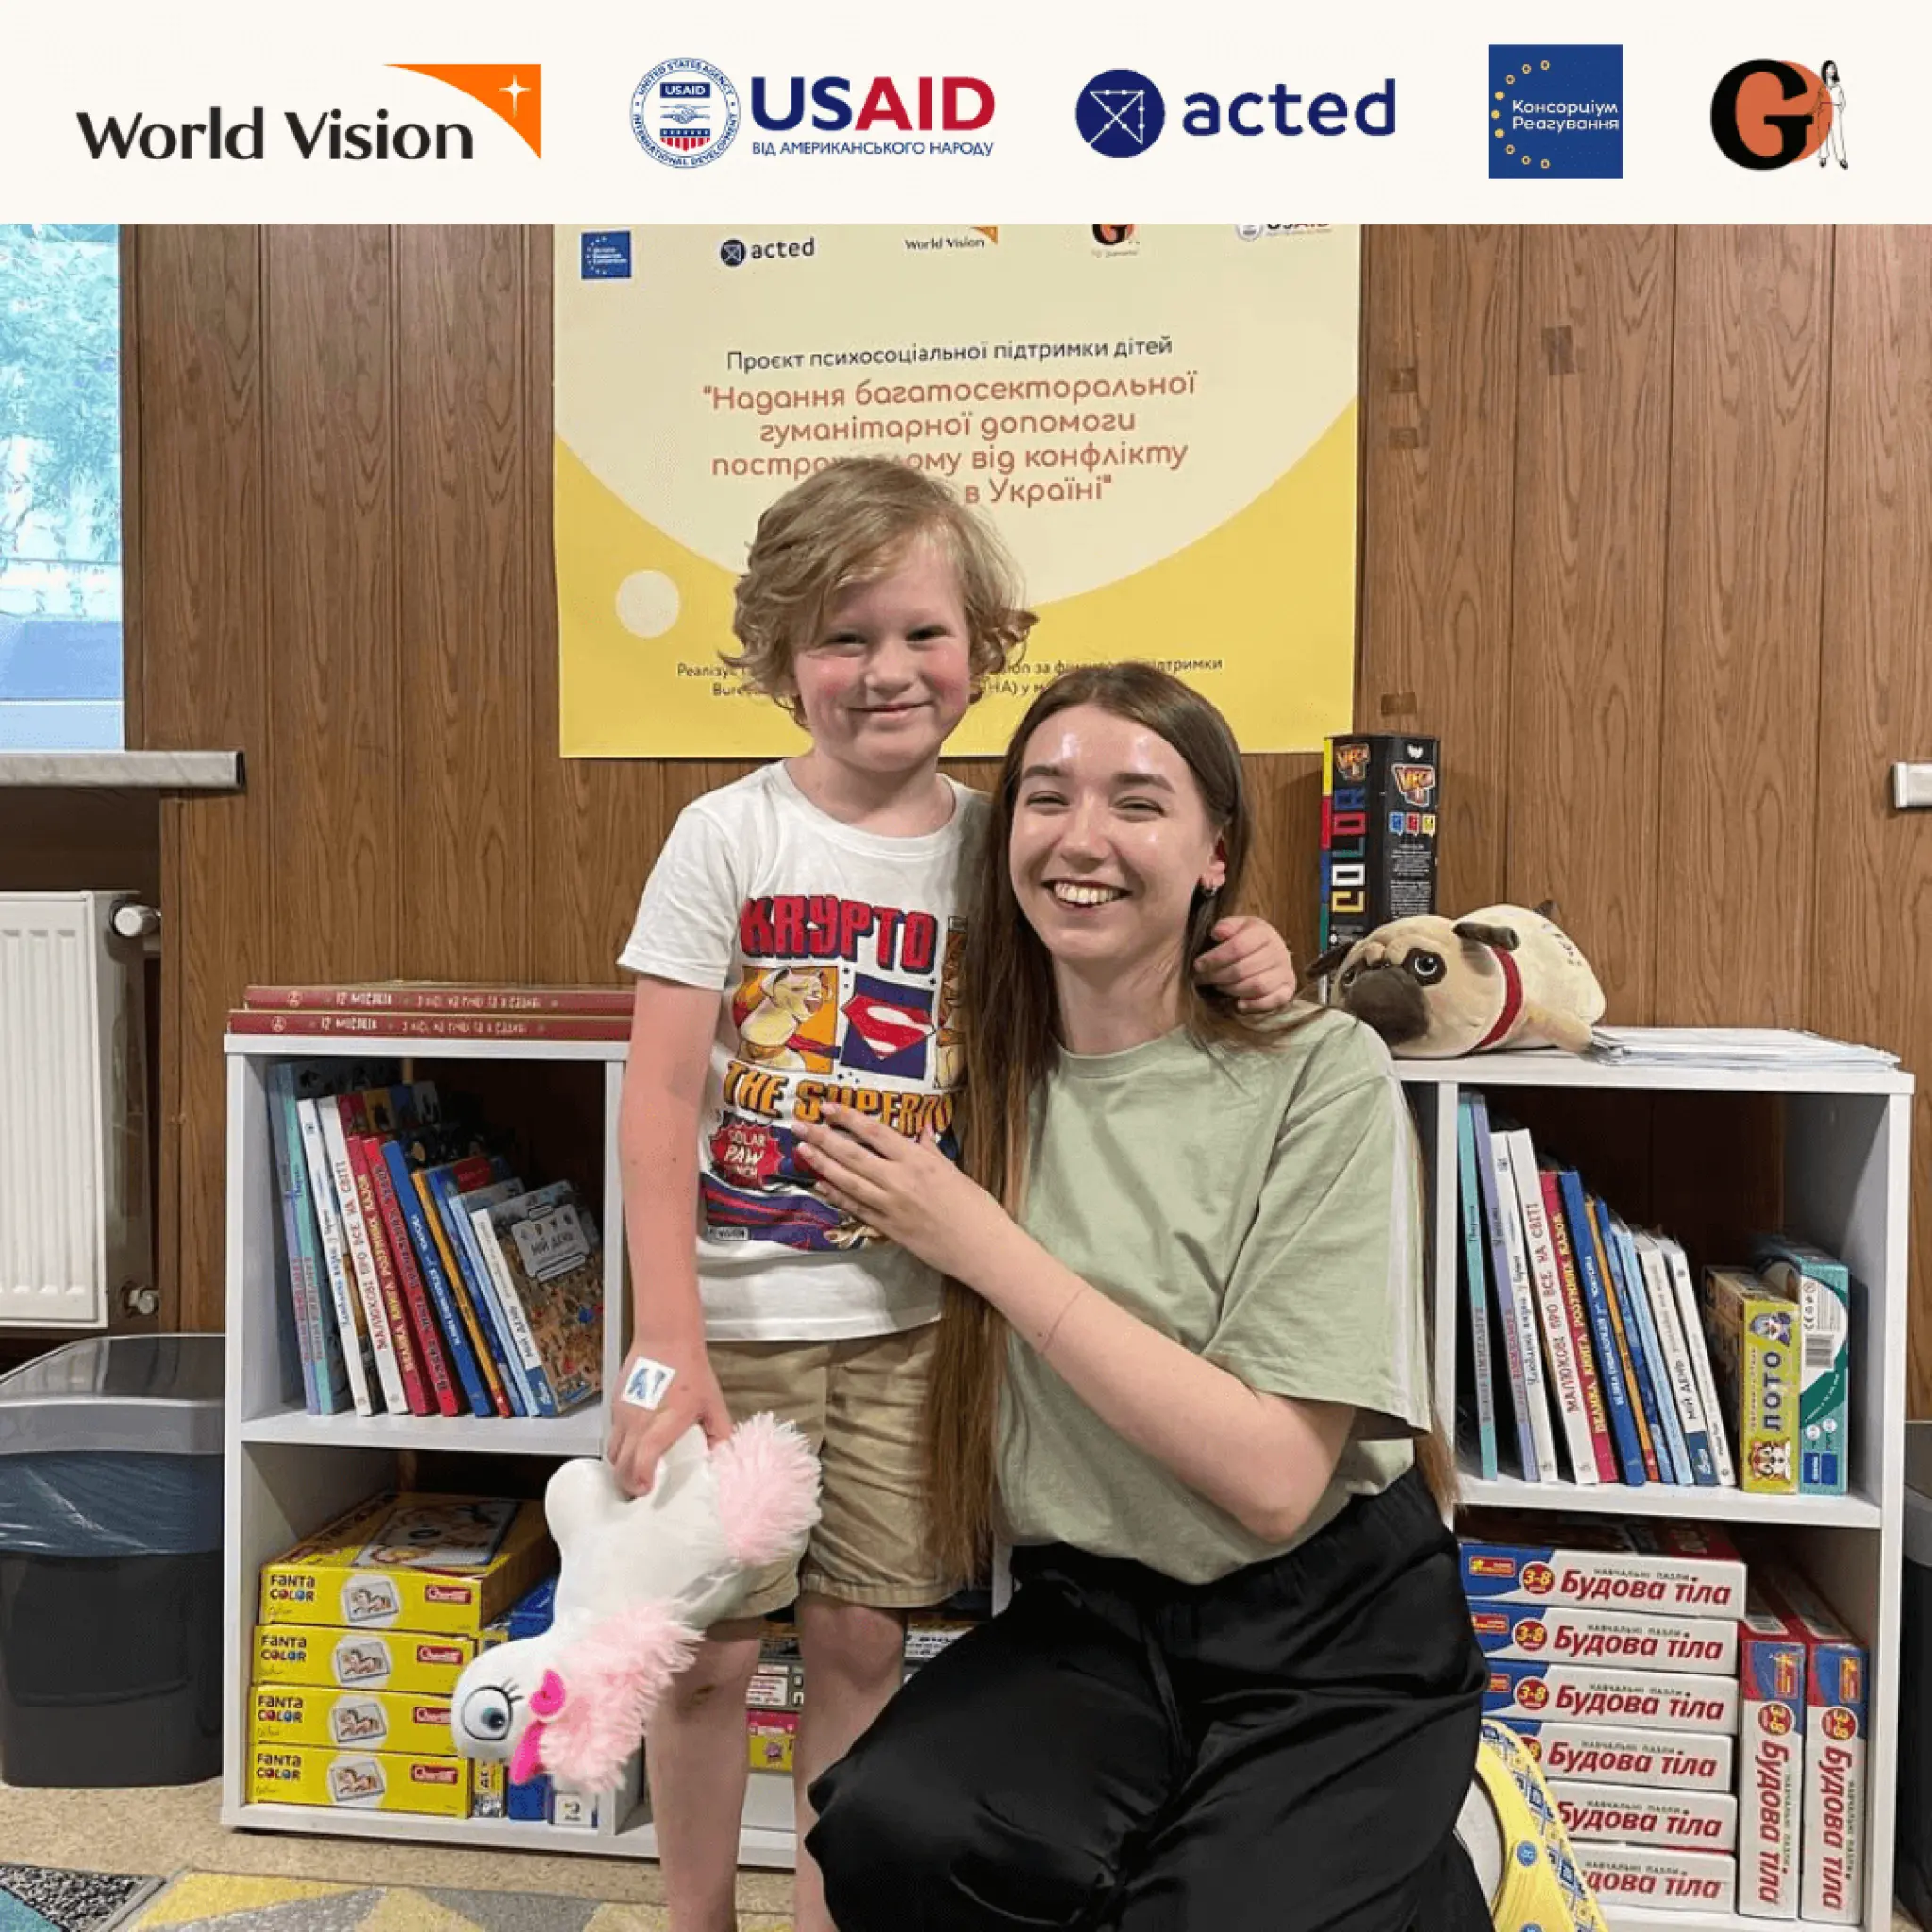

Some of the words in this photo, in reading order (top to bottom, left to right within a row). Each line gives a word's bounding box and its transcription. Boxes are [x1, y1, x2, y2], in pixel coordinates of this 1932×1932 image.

[751, 238, 815, 259] acted
[905, 237, 942, 250] World
[946, 236, 985, 249] Vision
[727, 351, 805, 374] Проєкт
[810, 341, 987, 367] психосоціальної
[994, 340, 1108, 362] підтримки
[1113, 336, 1173, 358] дітей
[856, 369, 1198, 406] багатосекторальної
[760, 411, 973, 449] гуманітарної
[981, 412, 1136, 441] допомоги
[972, 445, 1015, 475] від
[1025, 441, 1189, 473] конфлікту
[965, 484, 980, 504] в
[1332, 788, 1366, 913] COLOR
[740, 894, 938, 974] KRYPTO
[724, 1062, 789, 1120] THE
[724, 1144, 765, 1166] PAW
[1528, 1201, 1543, 1238] СВІТІ
[1537, 1244, 1548, 1263] НА
[1541, 1270, 1556, 1297] ВСЕ
[1548, 1302, 1562, 1329] ПРО
[1554, 1335, 1579, 1414] МАЛЮКОВІ
[1762, 1351, 1781, 1431] ЛОТО
[270, 1588, 314, 1602] COLOR
[1523, 1570, 1552, 1586] 3-8
[1561, 1569, 1665, 1602] Будова
[1674, 1577, 1732, 1605] тіла
[1516, 1627, 1545, 1642] 3-8
[1554, 1625, 1658, 1657] Будова
[1667, 1631, 1723, 1660] тіла
[260, 1648, 306, 1662] COLOR
[1518, 1686, 1546, 1702] 3-8
[1556, 1684, 1660, 1716] Будова
[1669, 1691, 1724, 1720] тіла
[258, 1709, 303, 1723] COLOR
[256, 1767, 301, 1781] COLOR
[1548, 1741, 1653, 1774] Будова
[1661, 1749, 1718, 1777] тіла
[1755, 1740, 1789, 1843] Будова
[1818, 1745, 1853, 1849] Будова
[1557, 1801, 1658, 1832] Будова
[1667, 1808, 1723, 1837] тіла
[1581, 1869, 1657, 1894] дова
[1665, 1869, 1722, 1899] тіла
[1759, 1851, 1788, 1905] тіла
[1822, 1857, 1851, 1911] тіла
